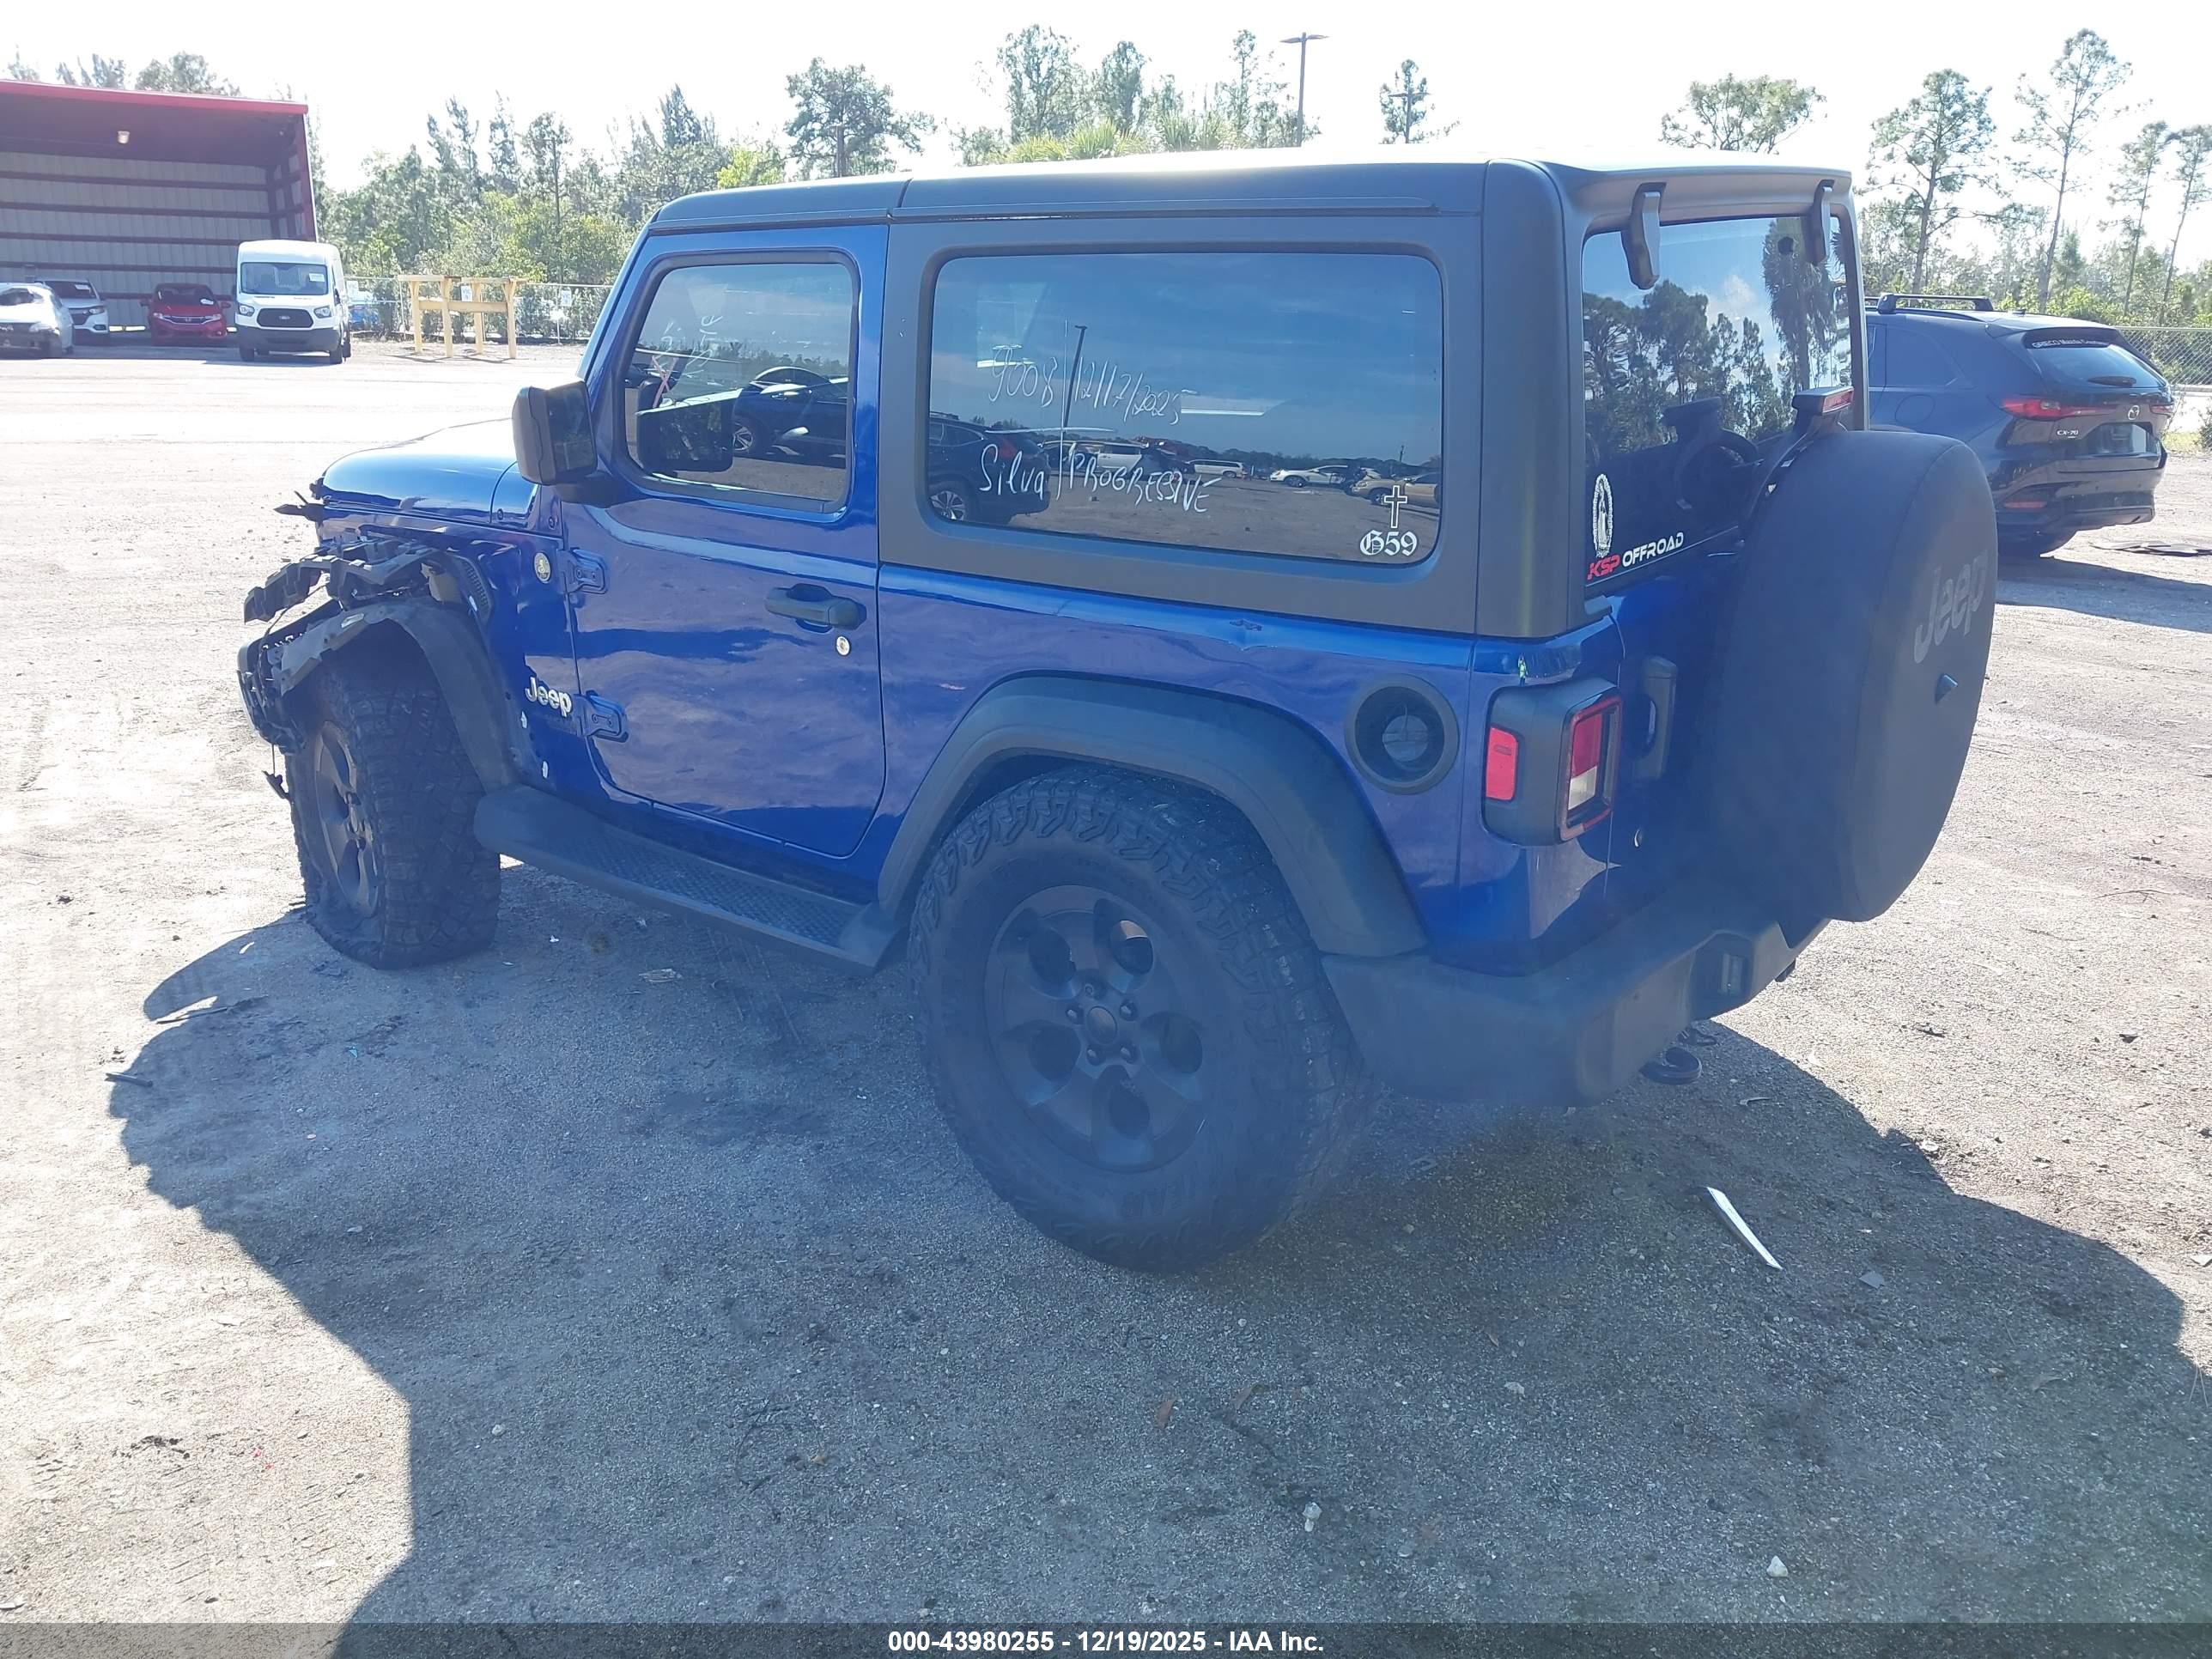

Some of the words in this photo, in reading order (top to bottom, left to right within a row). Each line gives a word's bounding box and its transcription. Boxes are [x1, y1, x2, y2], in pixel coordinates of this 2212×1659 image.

[978, 443, 1045, 501] Silva
[1068, 447, 1223, 514] PROGRESSIVE
[1586, 553, 1622, 581] KSP
[1621, 532, 1685, 568] OFFROAD
[1913, 550, 1989, 664] Jeep
[524, 676, 574, 718] Jeep
